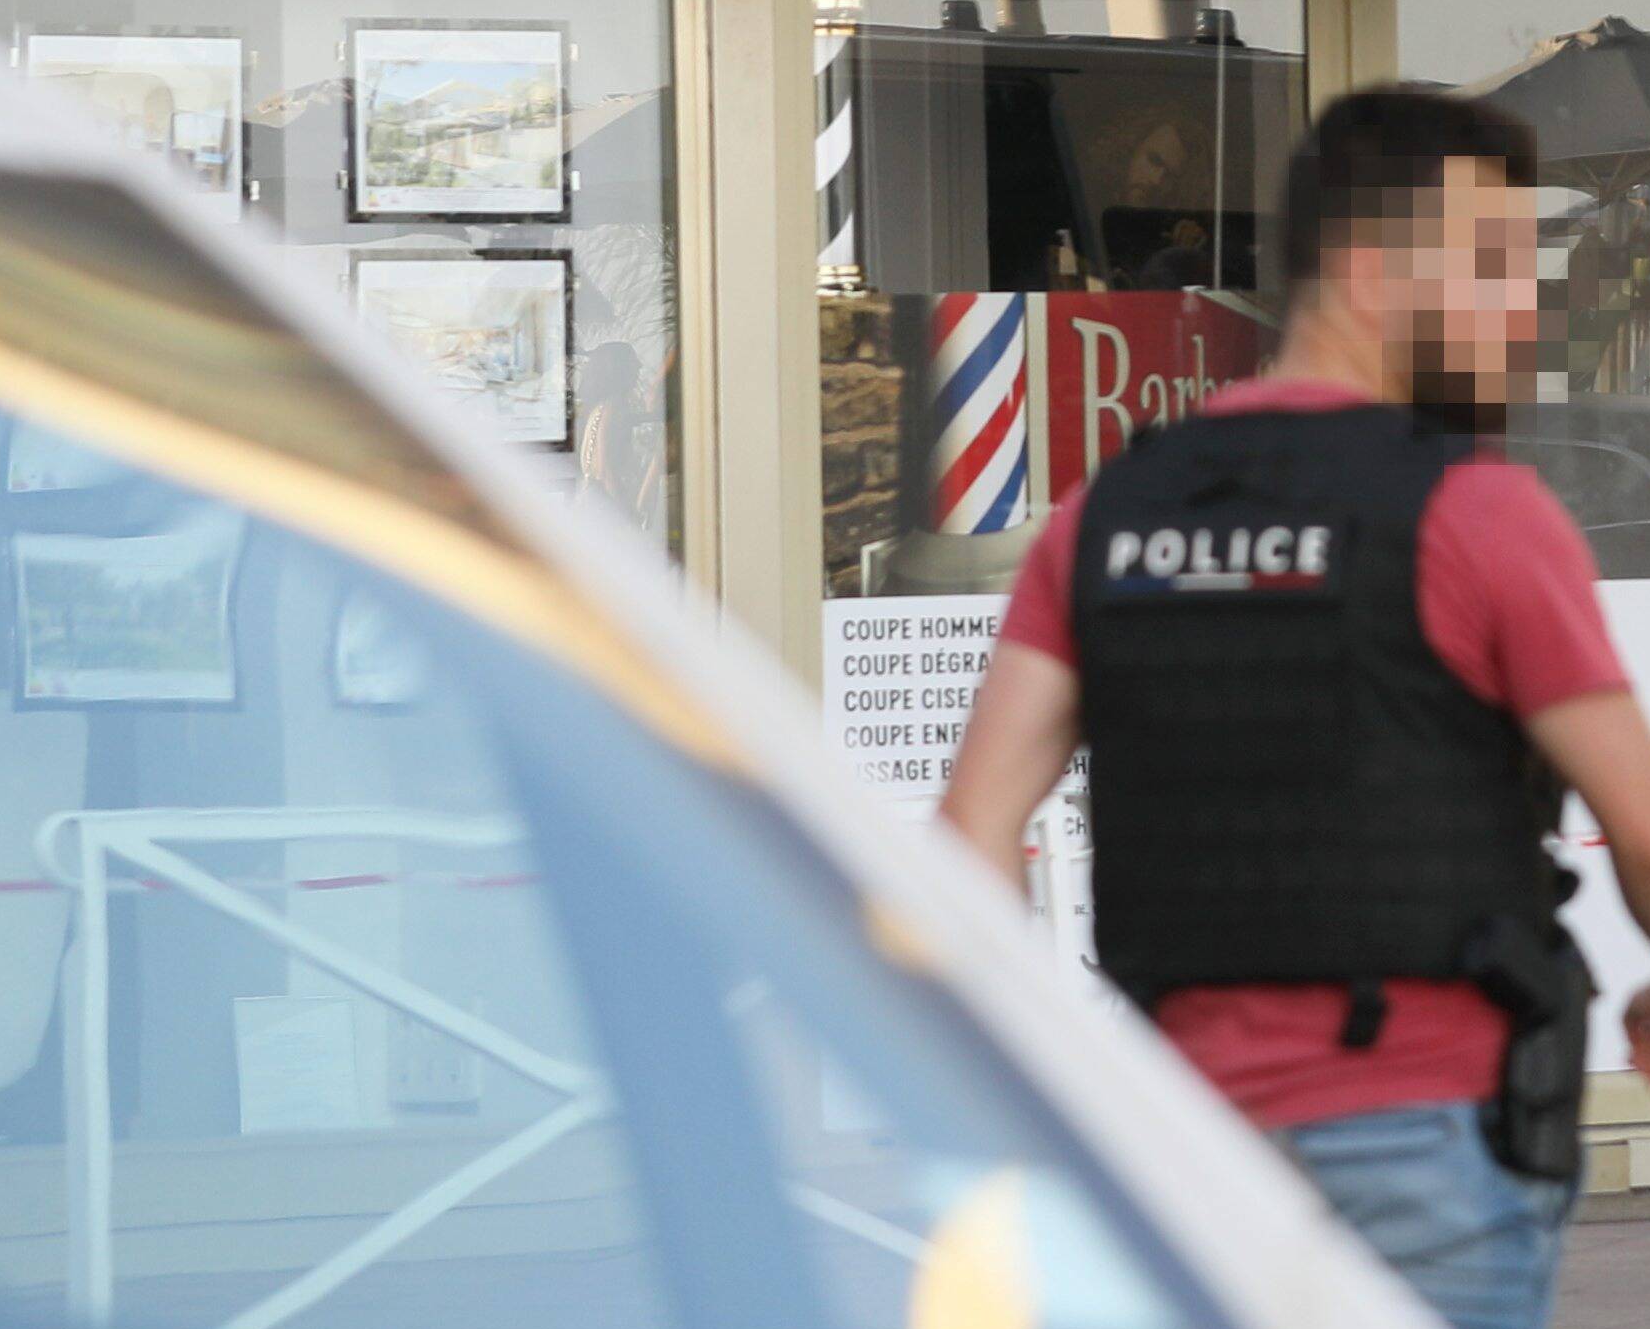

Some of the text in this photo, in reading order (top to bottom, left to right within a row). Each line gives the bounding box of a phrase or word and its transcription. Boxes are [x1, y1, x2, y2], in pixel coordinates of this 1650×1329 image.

[1105, 526, 1331, 577] POLICE
[842, 618, 912, 641] COUPE
[843, 648, 990, 677] COUPE DÉGRA
[844, 689, 914, 712] COUPE
[844, 722, 963, 748] COUPE ENF
